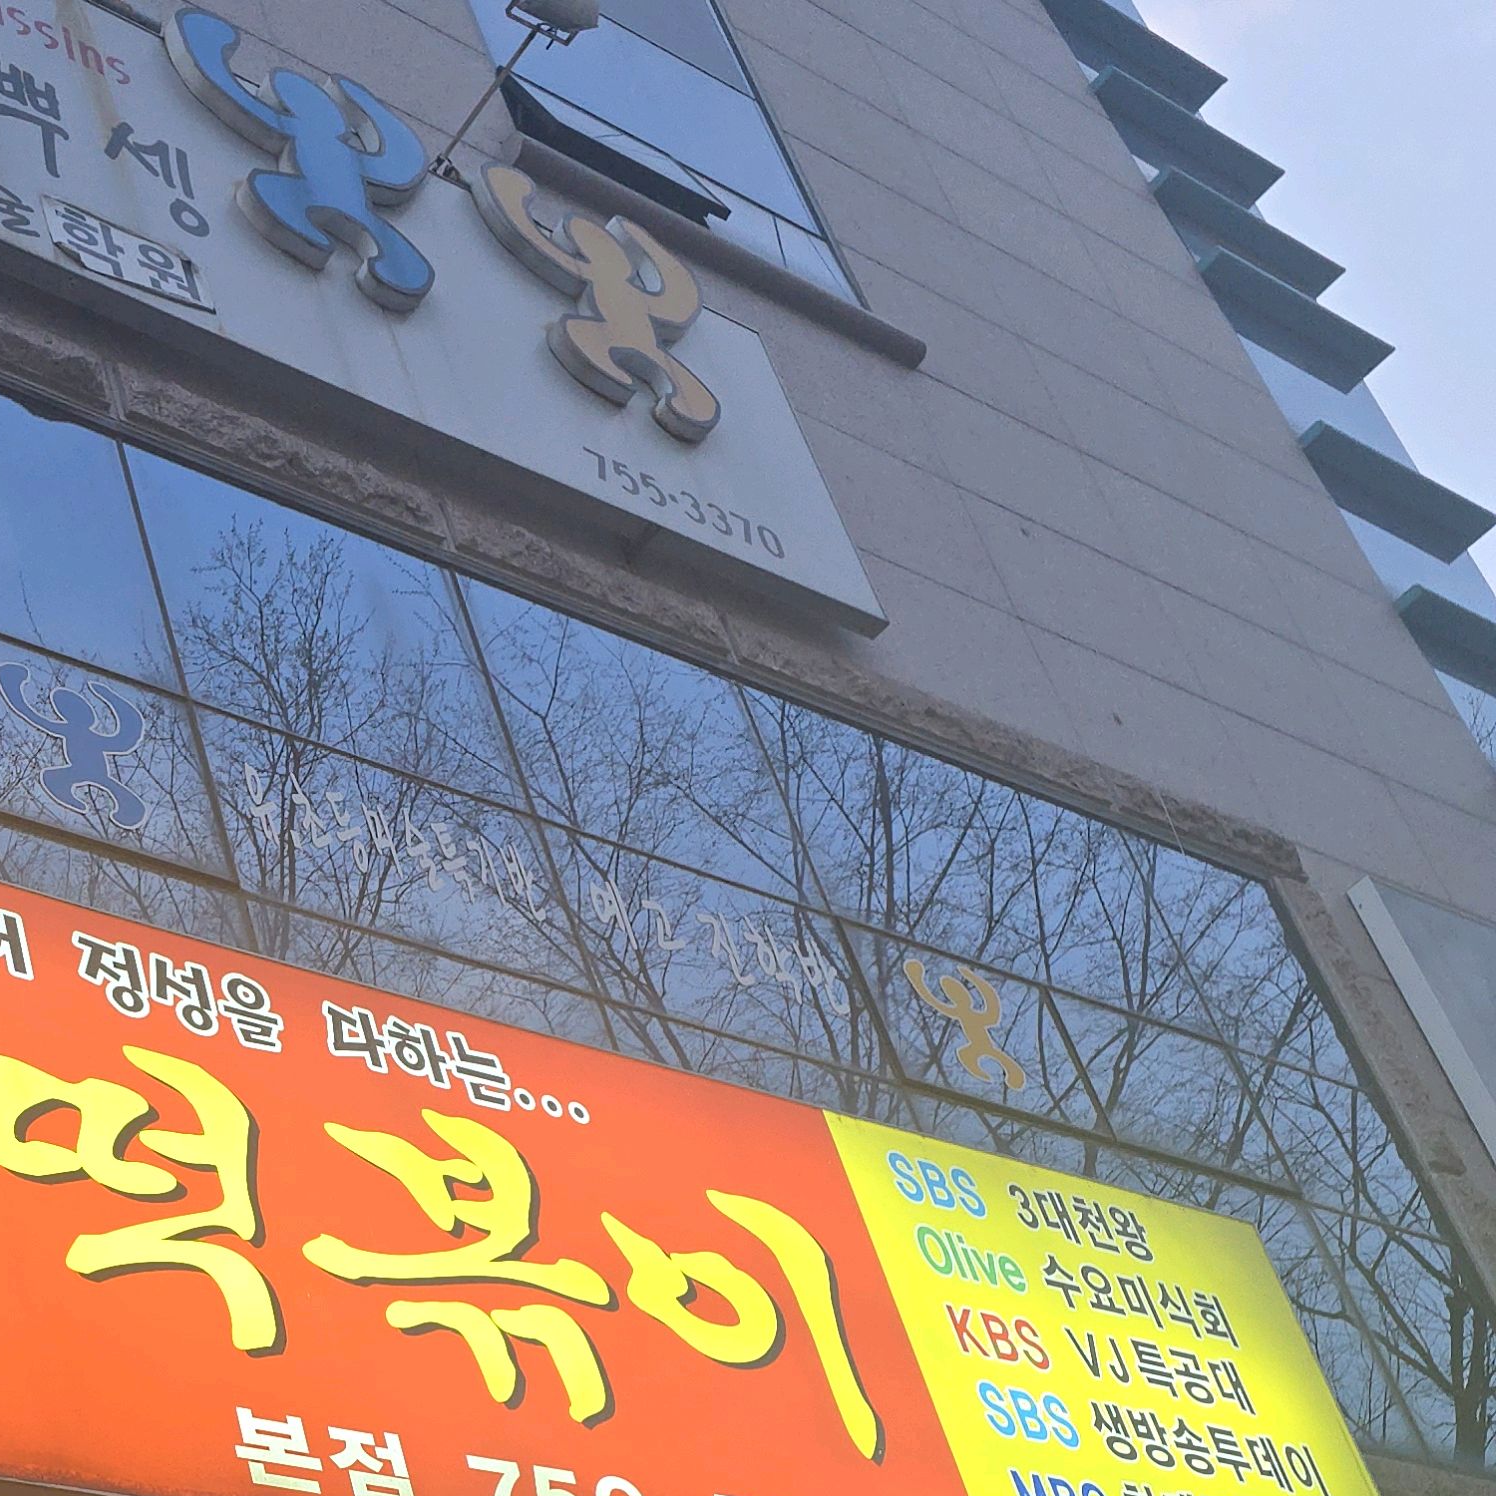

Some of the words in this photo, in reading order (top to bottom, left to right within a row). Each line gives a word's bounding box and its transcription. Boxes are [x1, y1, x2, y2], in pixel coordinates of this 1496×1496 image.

[69, 927, 284, 1053] 정성을
[322, 998, 592, 1126] 다하는...
[886, 1150, 987, 1218] SBS
[1007, 1183, 1155, 1264] 3대천왕
[916, 1225, 1027, 1293] Olive
[1041, 1252, 1240, 1348] 수요미식회
[944, 1303, 1051, 1371] KBS
[977, 1380, 1081, 1449] SBS
